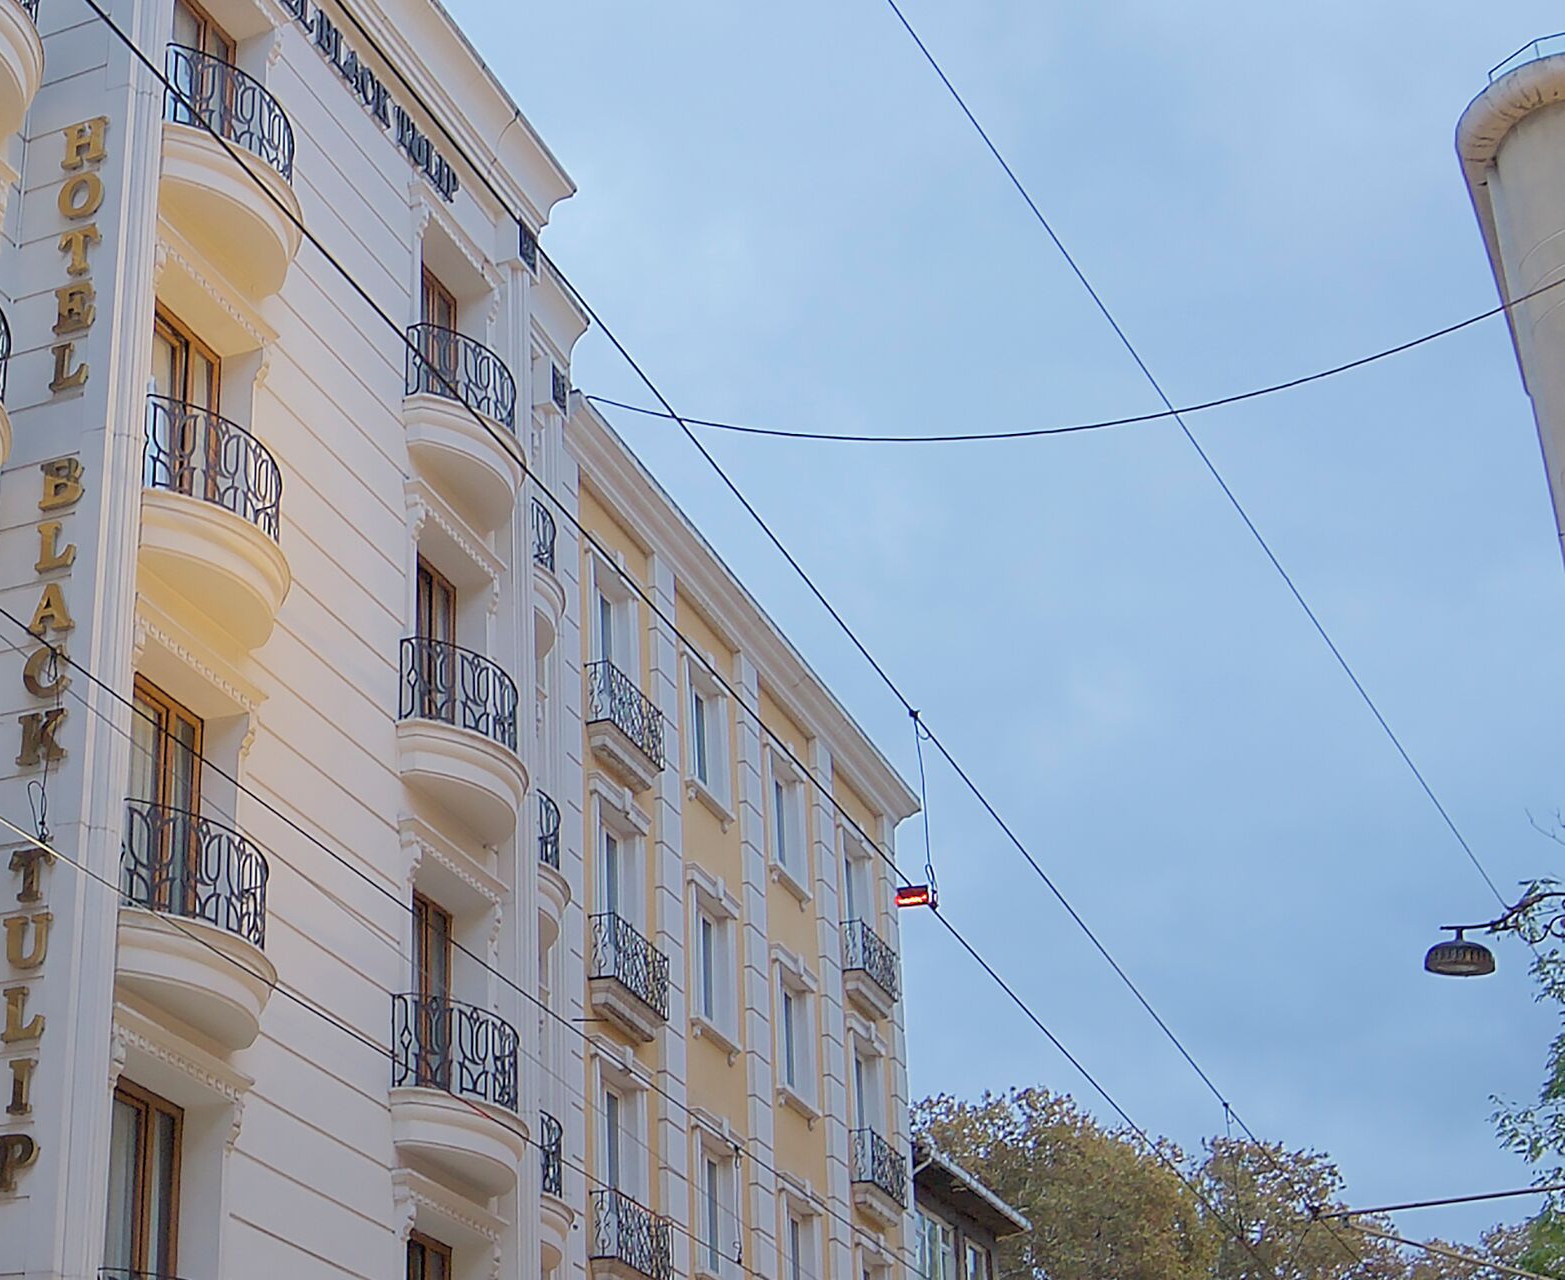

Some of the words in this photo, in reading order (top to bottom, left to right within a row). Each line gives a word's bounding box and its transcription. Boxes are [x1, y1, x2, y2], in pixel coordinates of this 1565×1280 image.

[314, 6, 391, 132] BLACK
[393, 105, 460, 203] TULIP
[48, 116, 111, 394] HOTEL
[15, 457, 85, 766] BLACK
